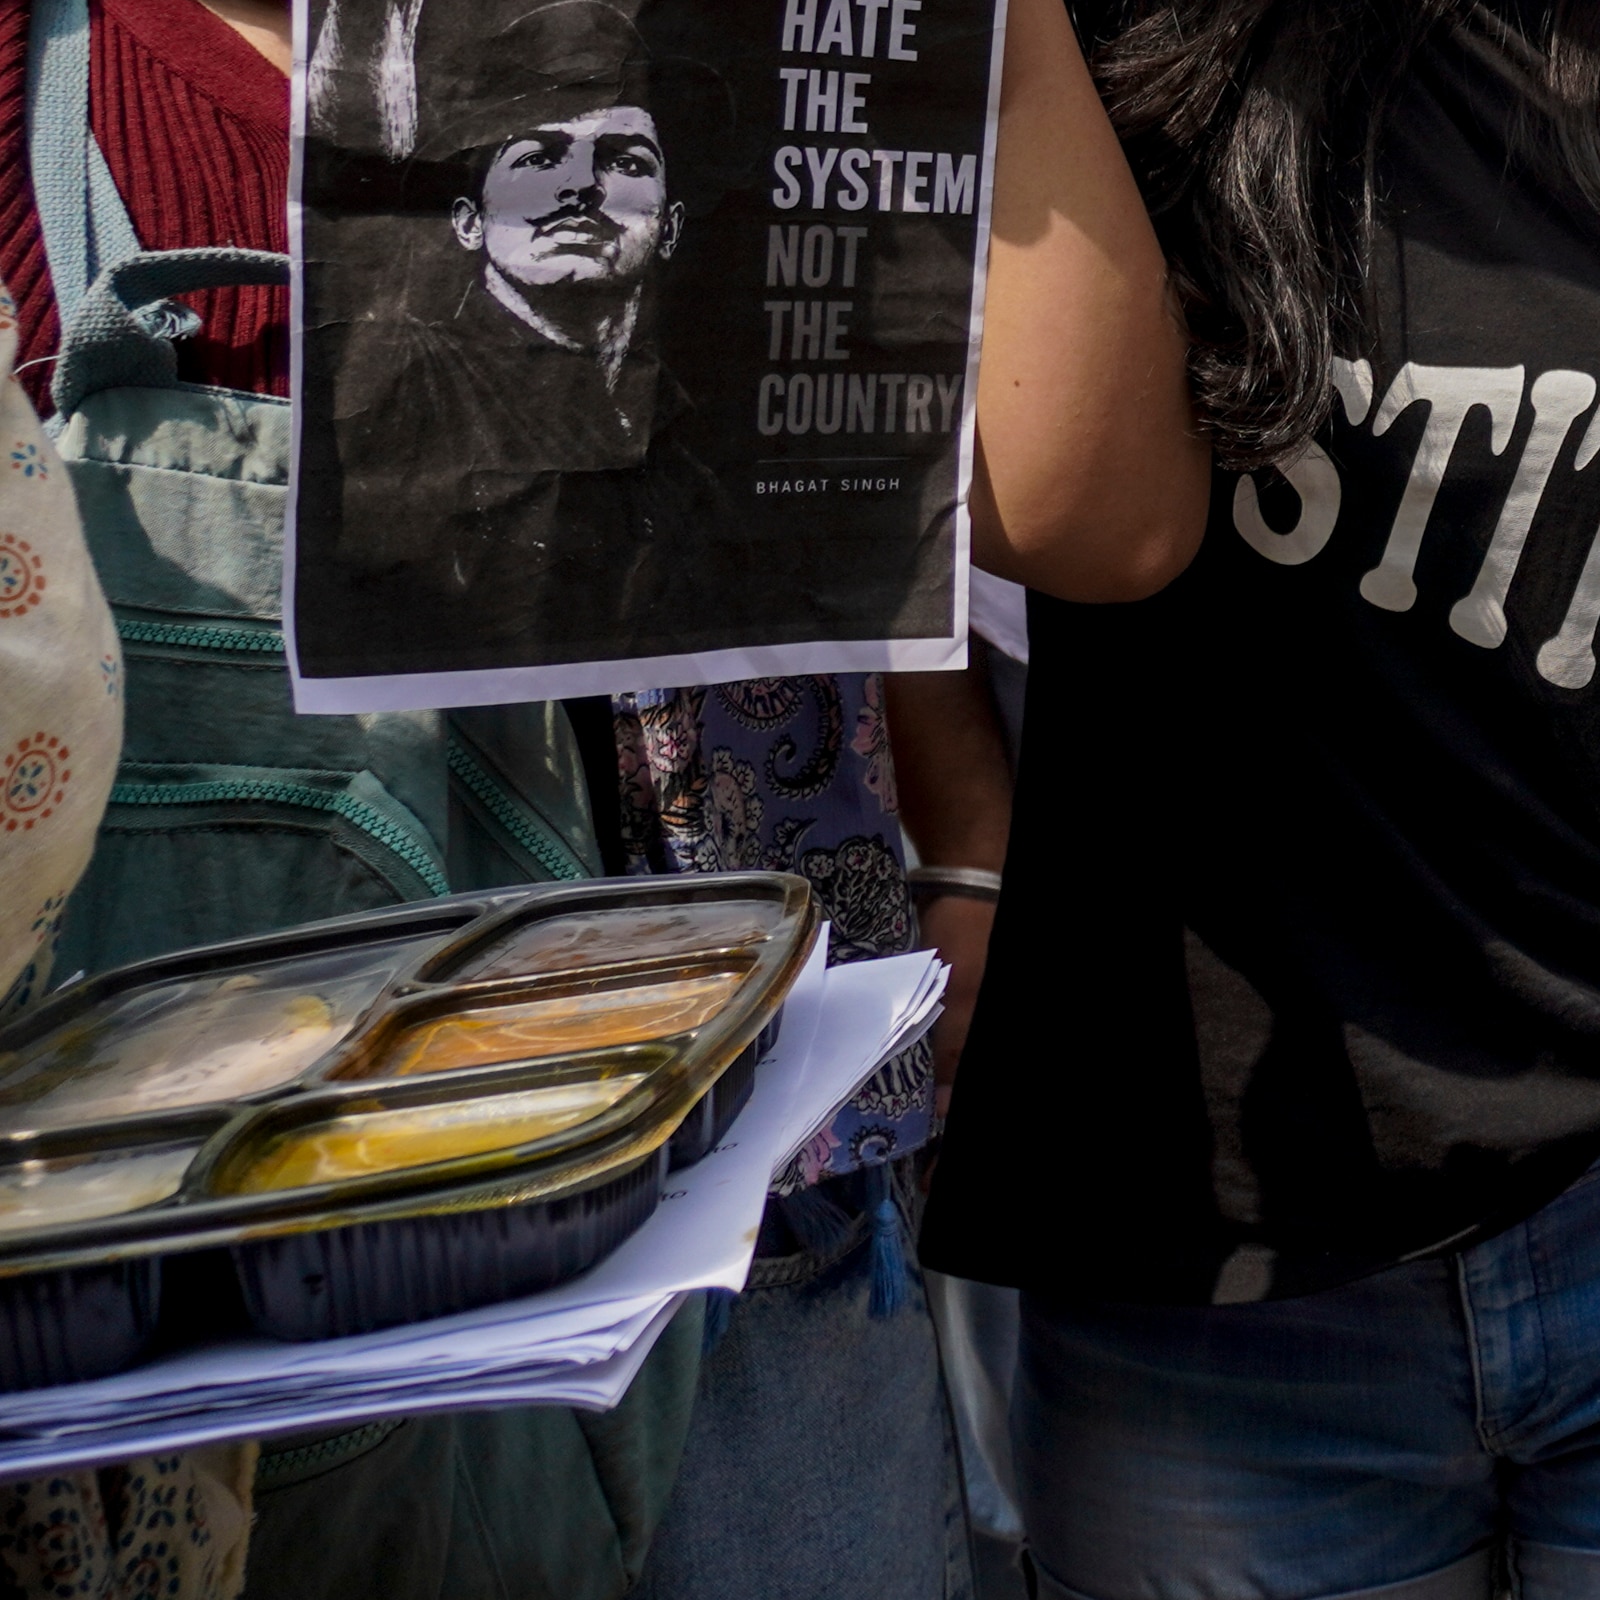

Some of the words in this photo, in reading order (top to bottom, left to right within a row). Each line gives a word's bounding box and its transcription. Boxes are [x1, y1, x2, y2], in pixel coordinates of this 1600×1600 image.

[779, 67, 872, 134] THE
[772, 145, 978, 215] SYSTEM
[765, 224, 869, 288] NOT
[763, 300, 854, 361] THE
[756, 373, 964, 437] COUNTRY
[755, 478, 830, 495] BHAGAT
[840, 477, 901, 492] SINGH
